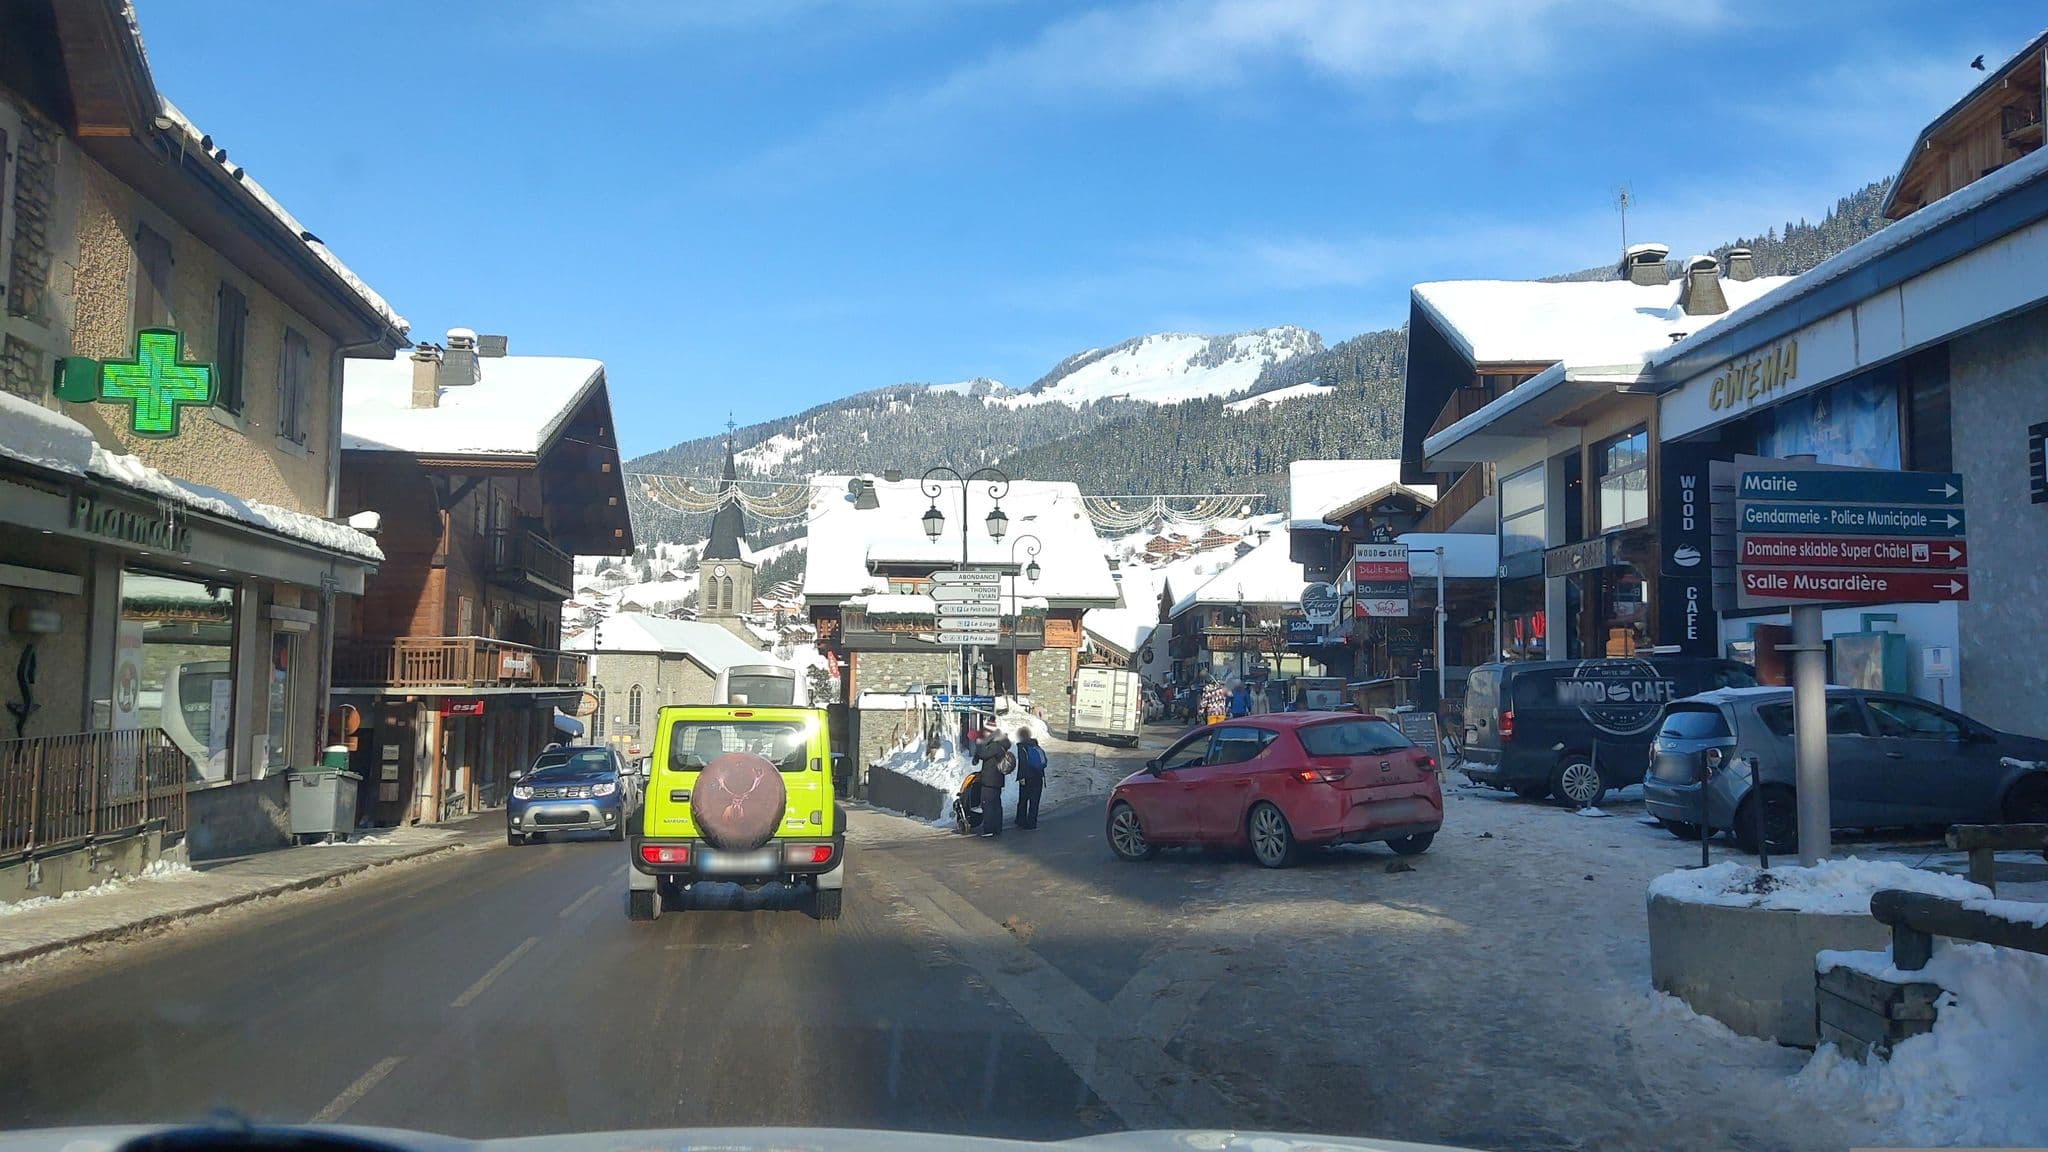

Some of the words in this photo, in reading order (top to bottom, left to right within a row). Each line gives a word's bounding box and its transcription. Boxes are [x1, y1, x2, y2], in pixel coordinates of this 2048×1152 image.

[1745, 475, 1798, 491] Mairie
[1680, 476, 1697, 531] WOOD
[1746, 508, 1821, 524] Gendarmerie
[1831, 509, 1865, 525] Police
[1867, 510, 1928, 529] Municipale
[1747, 541, 1797, 557] Domaine
[1800, 541, 1839, 557] skiable
[1841, 543, 1872, 561] Super
[1874, 542, 1910, 559] Châtel
[1747, 573, 1789, 590] Salle
[1793, 574, 1888, 591] Musardière
[1686, 586, 1699, 640] CAFE
[1556, 681, 1607, 703] WOOD
[1632, 680, 1676, 702] CAFE
